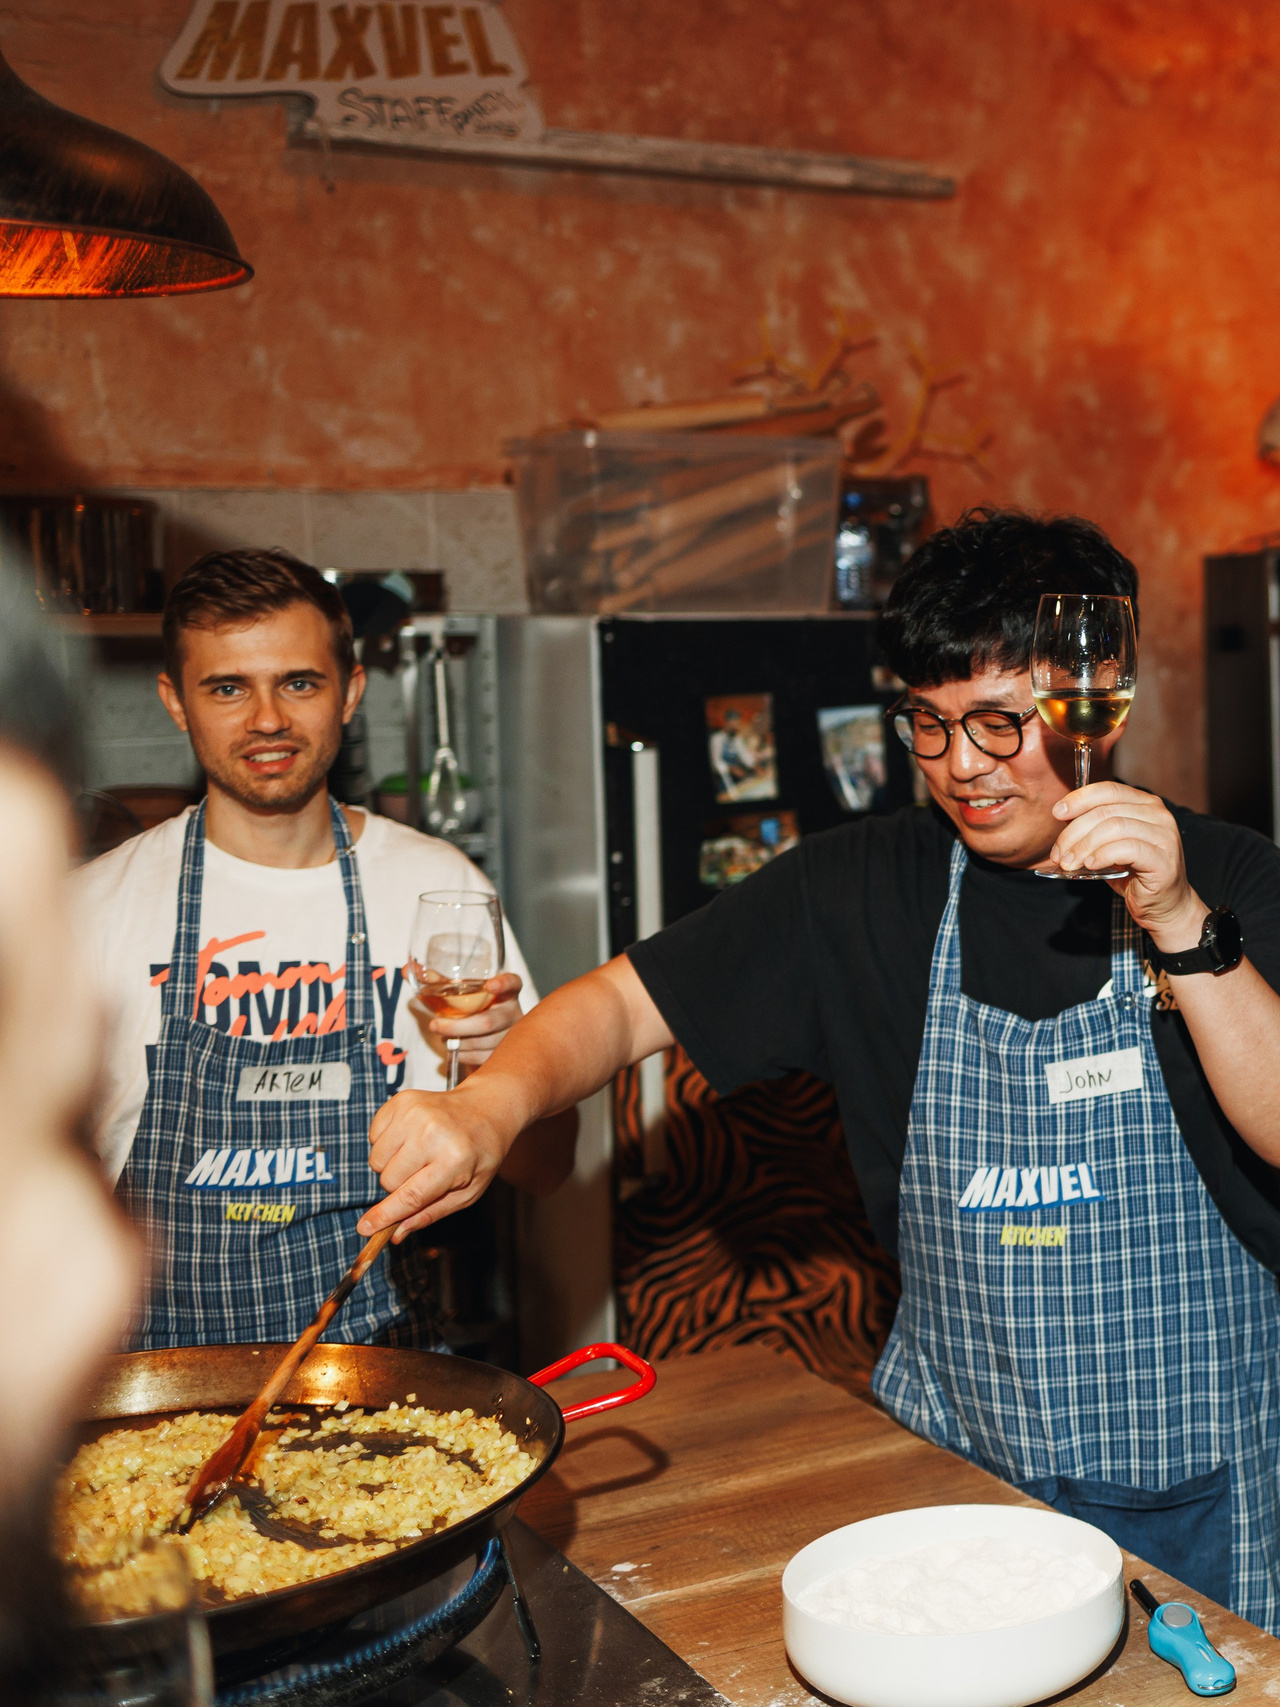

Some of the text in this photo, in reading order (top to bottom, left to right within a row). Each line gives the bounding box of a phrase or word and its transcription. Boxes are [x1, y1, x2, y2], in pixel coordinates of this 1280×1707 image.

[175, 0, 514, 81] MAXVEL
[337, 87, 457, 132] STAFF
[184, 1146, 336, 1190] MAXVEL
[957, 1162, 1105, 1212] MAXVEL
[226, 1202, 297, 1223] KITCHEN
[1000, 1225, 1067, 1247] KITCHEN
